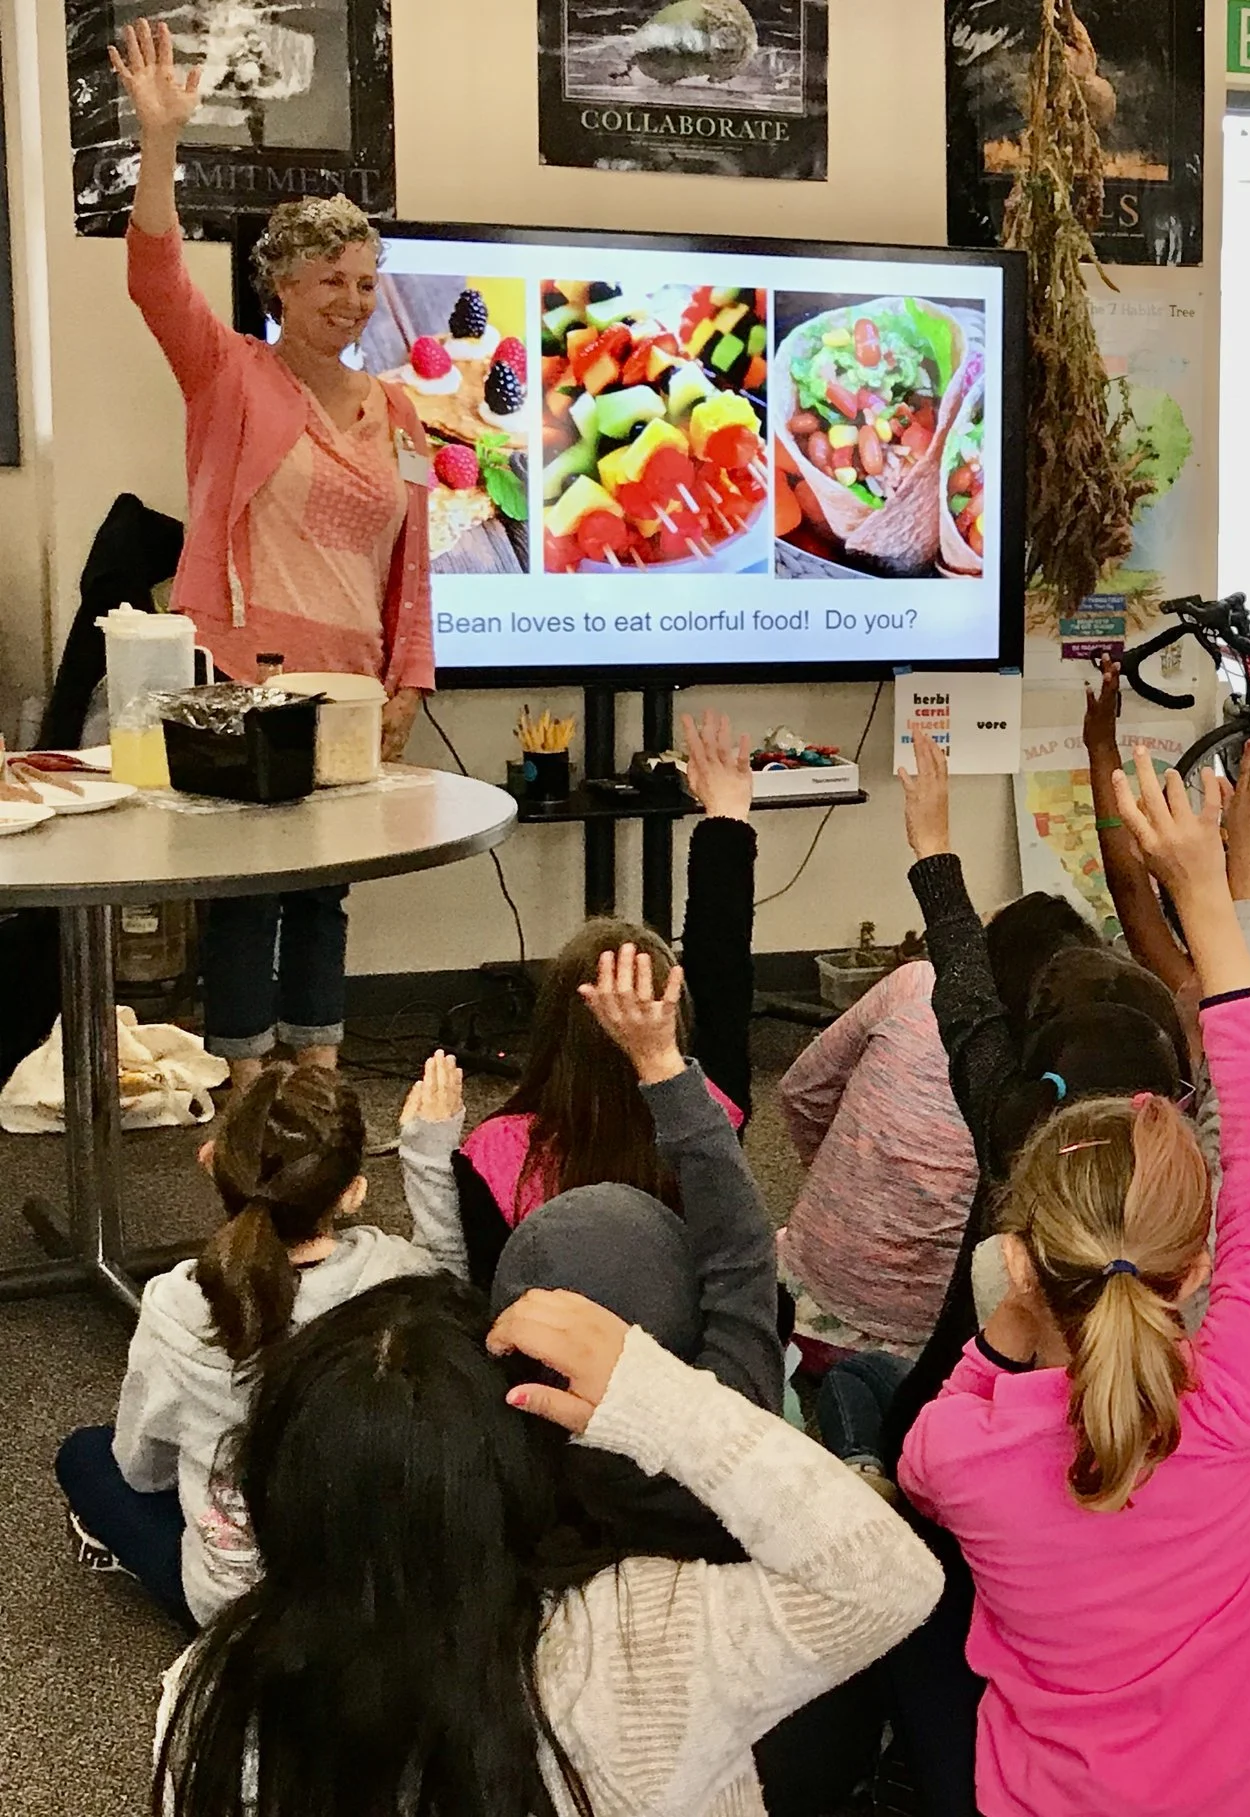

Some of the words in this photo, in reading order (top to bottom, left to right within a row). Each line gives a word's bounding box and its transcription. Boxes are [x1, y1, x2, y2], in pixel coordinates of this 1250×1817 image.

[581, 109, 790, 142] COLLABORATE
[1168, 304, 1196, 318] Tree
[437, 612, 501, 635] Bean
[511, 611, 576, 634] loves
[584, 612, 607, 633] to
[614, 612, 653, 633] eat
[659, 609, 746, 632] colorful
[752, 608, 810, 632] food!
[825, 609, 858, 631] Do
[864, 608, 919, 634] you?
[913, 693, 950, 705] herbi
[915, 706, 950, 717] carni
[977, 721, 1007, 730] vore
[1024, 740, 1059, 761] MAP
